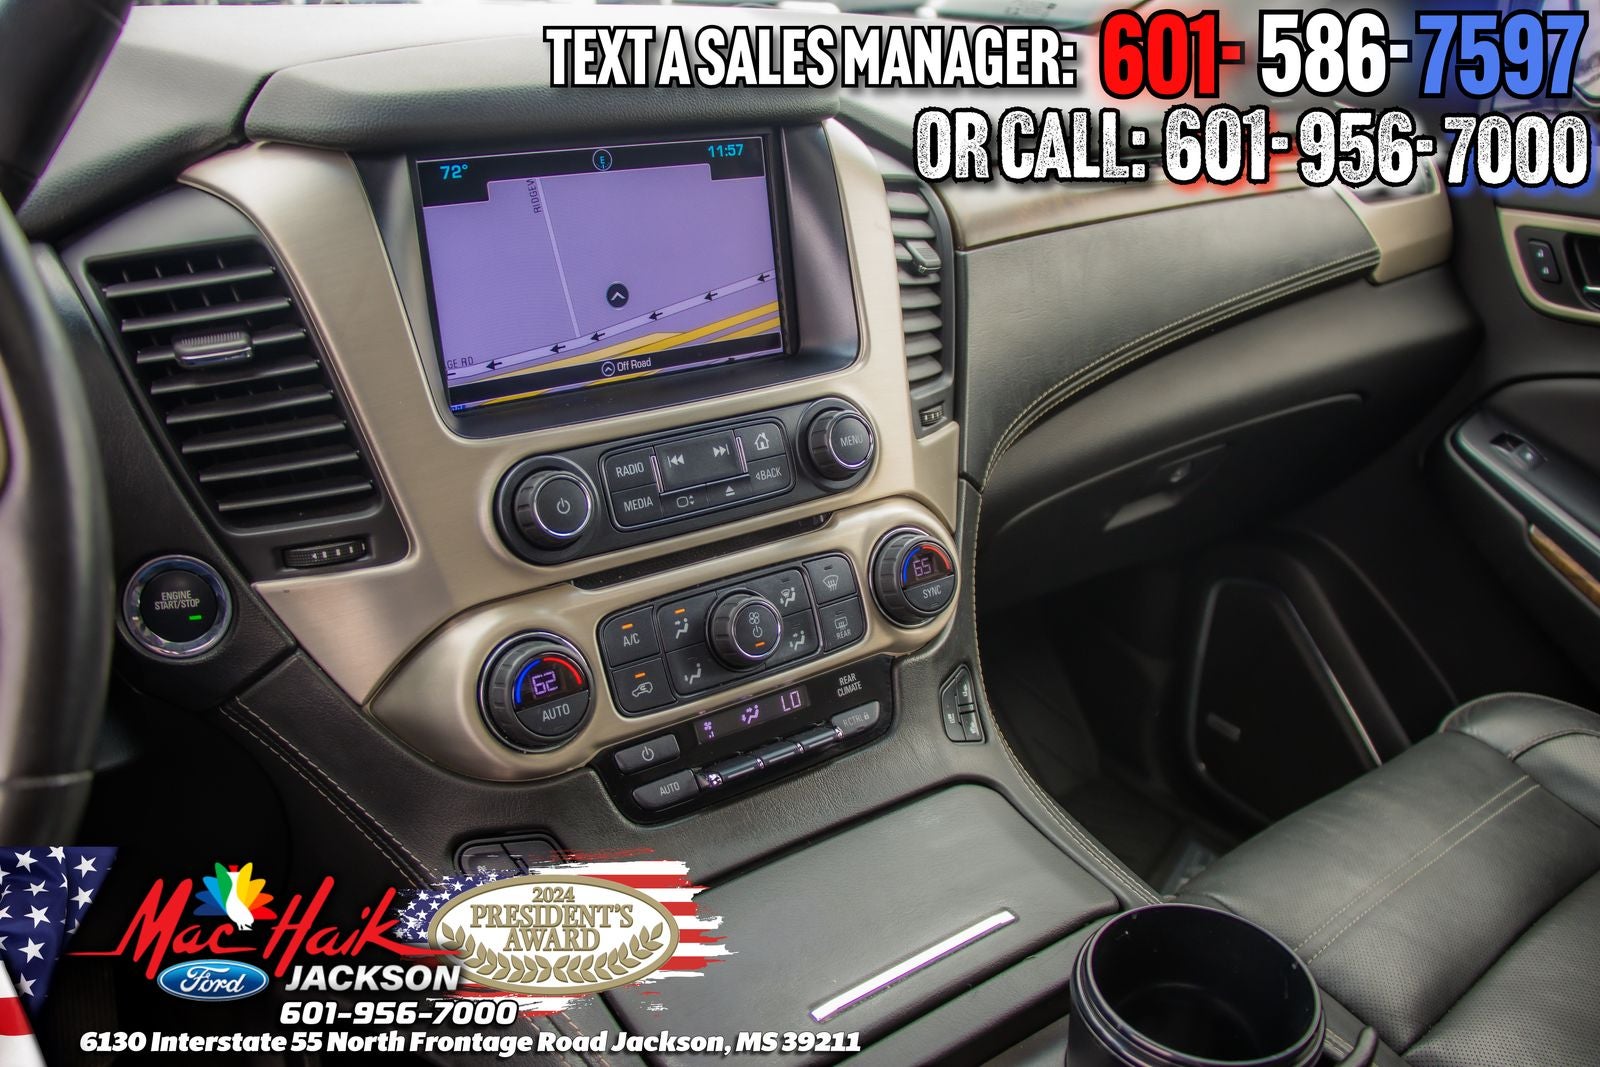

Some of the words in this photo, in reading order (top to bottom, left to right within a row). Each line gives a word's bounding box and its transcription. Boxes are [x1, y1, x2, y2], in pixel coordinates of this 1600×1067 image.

[707, 143, 745, 159] 11:57
[617, 361, 629, 373] Off
[631, 357, 652, 371] Road
[839, 434, 864, 449] MENU
[615, 461, 645, 478] RADIO
[760, 466, 783, 482] BACK
[623, 496, 654, 513] MEDIA
[912, 557, 932, 577] 65
[161, 590, 192, 601] ENGINE
[922, 585, 942, 599] SYNC
[154, 598, 200, 610] START/STOP
[623, 633, 641, 647] A/C
[835, 628, 853, 639] REAR
[531, 671, 560, 696] 62
[839, 673, 857, 686] REAR
[837, 681, 863, 698] CLIMATE
[541, 703, 571, 723] AUTO
[659, 780, 681, 797] AUTO
